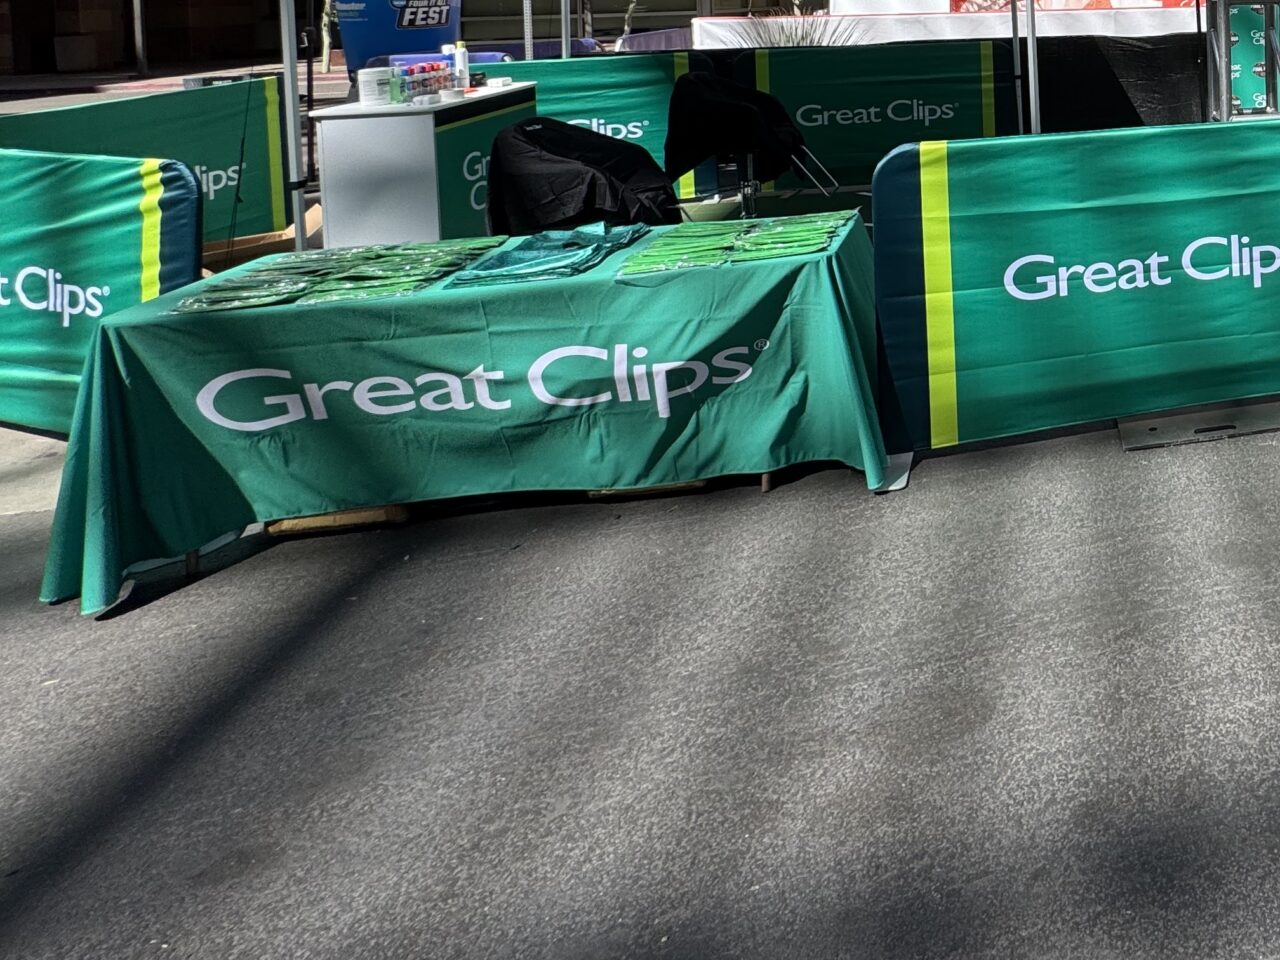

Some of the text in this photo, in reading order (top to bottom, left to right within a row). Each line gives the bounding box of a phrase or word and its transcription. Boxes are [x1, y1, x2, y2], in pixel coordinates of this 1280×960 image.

[402, 6, 450, 25] FEST
[796, 104, 882, 127] Great
[194, 165, 240, 200] lips
[1003, 251, 1172, 301] Great
[196, 367, 511, 431] Great
